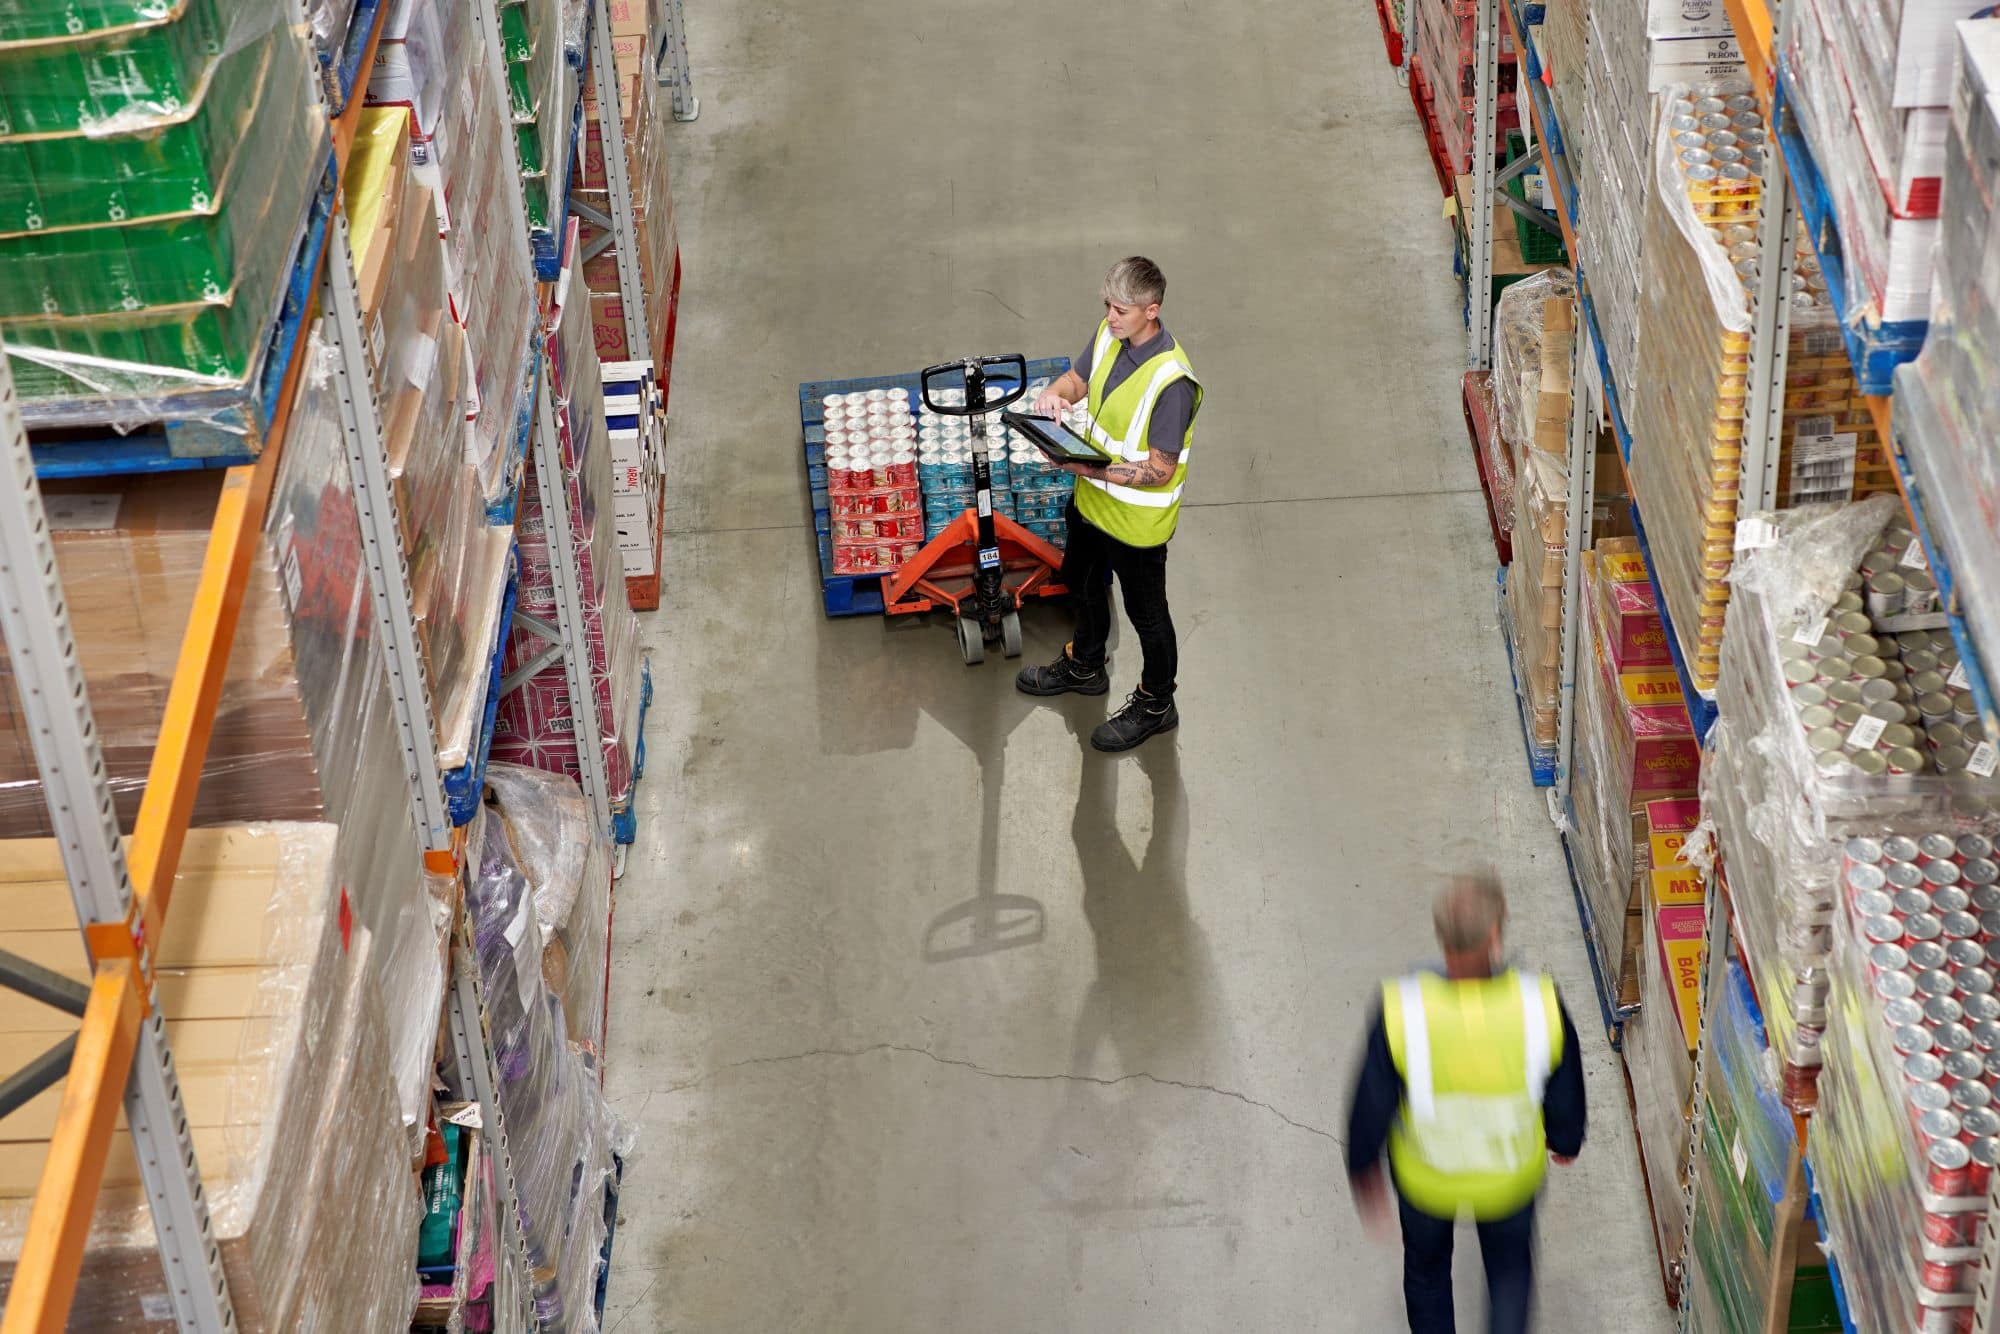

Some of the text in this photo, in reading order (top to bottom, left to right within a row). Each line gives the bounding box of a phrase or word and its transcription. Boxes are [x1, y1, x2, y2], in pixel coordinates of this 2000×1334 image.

[1708, 51, 1738, 59] PERONI
[982, 551, 998, 561] 184
[1637, 682, 1681, 695] NEW
[1677, 957, 1697, 989] BAG
[431, 1191, 441, 1214] EXTRA
